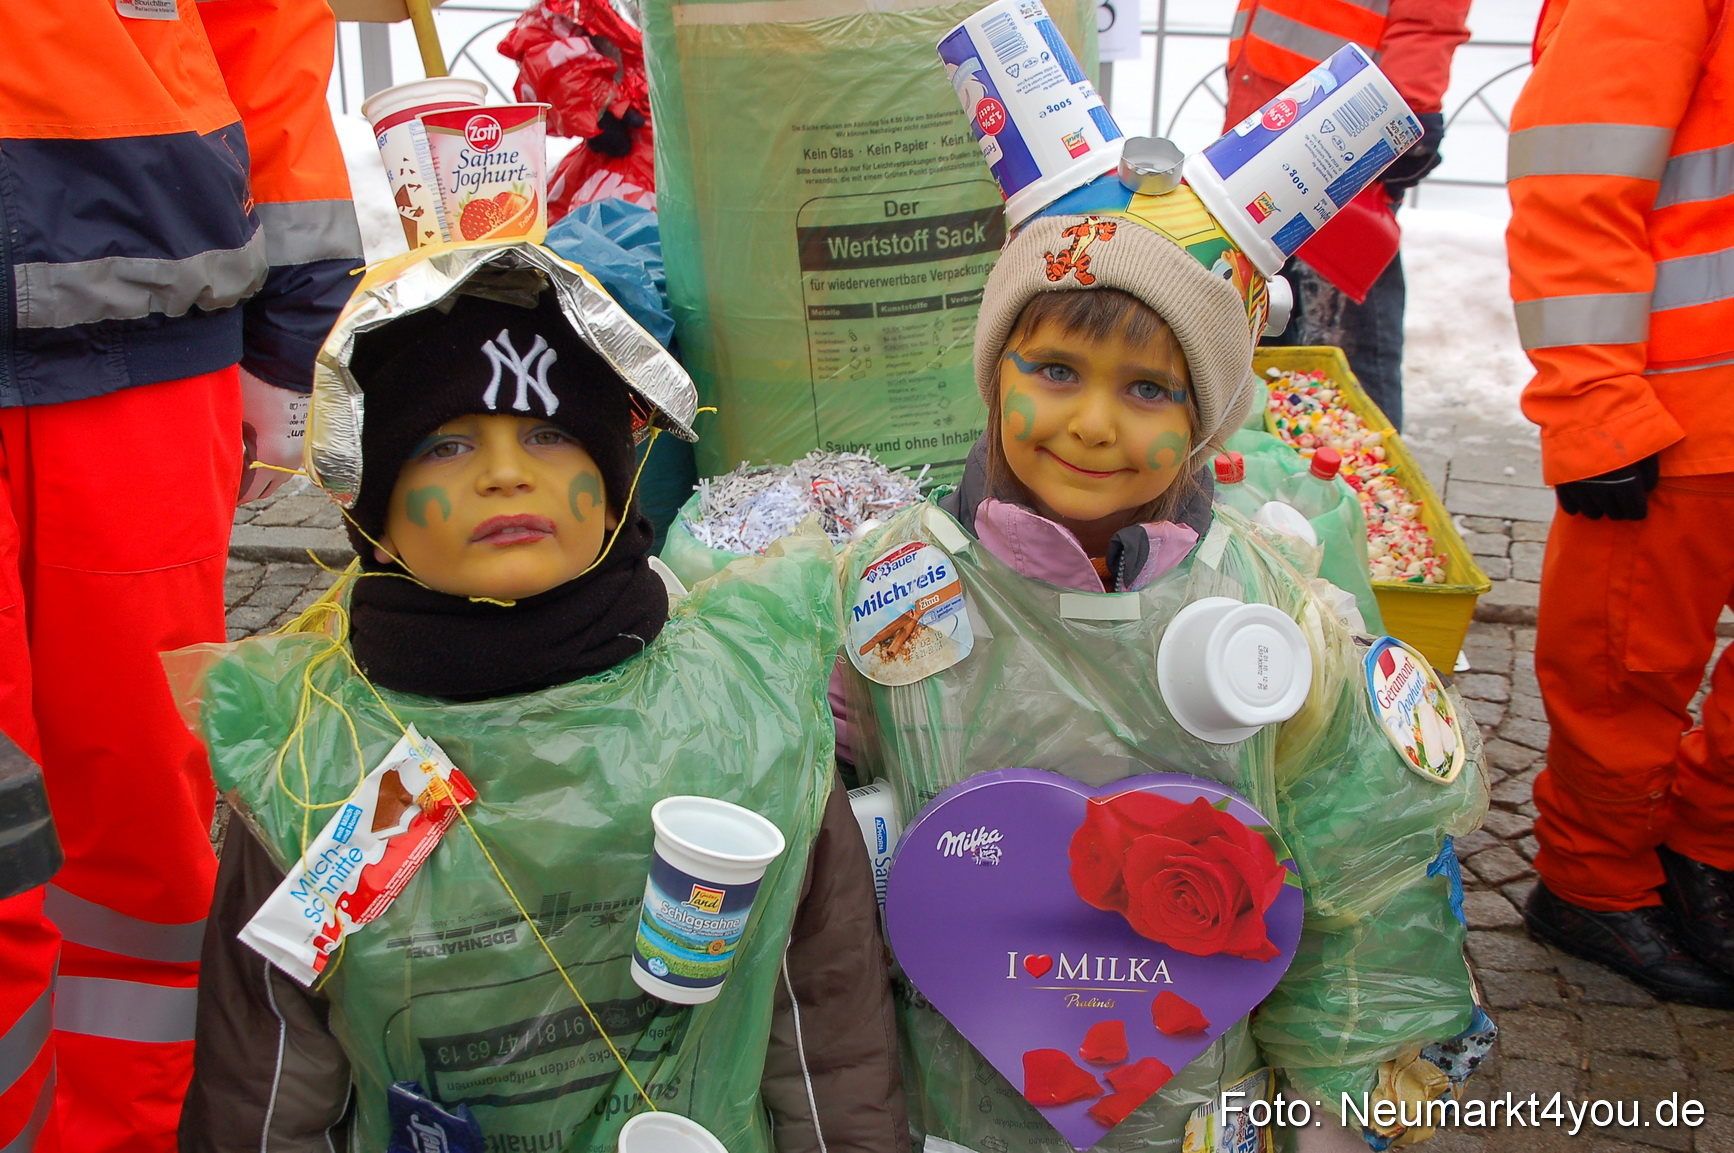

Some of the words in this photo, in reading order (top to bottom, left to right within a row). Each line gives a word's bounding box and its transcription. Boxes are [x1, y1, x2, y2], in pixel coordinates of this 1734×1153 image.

[458, 145, 518, 170] Sahne
[804, 148, 827, 160] Kein
[831, 147, 854, 159] Glas
[867, 144, 891, 156] Kein
[894, 141, 929, 155] Papier
[941, 134, 963, 147] Kein
[451, 163, 527, 194] Joghurt
[813, 166, 832, 174] diesen
[884, 200, 919, 218] Der
[828, 228, 929, 259] Wertstoff
[936, 221, 986, 249] Sack
[810, 279, 825, 291] für
[828, 275, 926, 290] wiederverwertbare
[876, 438, 900, 452] und
[905, 434, 938, 450] ohne
[853, 564, 946, 622] Milchreis
[1377, 656, 1415, 709] Géramont
[936, 825, 1004, 857] Milka
[661, 900, 740, 931] Schlagsahne
[1007, 951, 1018, 979] I
[1057, 952, 1174, 984] MILKA
[1064, 993, 1116, 1010] Pralinés
[534, 1022, 557, 1045] 81
[561, 1015, 585, 1037] 91
[437, 1043, 461, 1065] 13
[466, 1040, 491, 1061] 63
[539, 1055, 586, 1077] werden
[447, 1066, 538, 1092] mitgenommen
